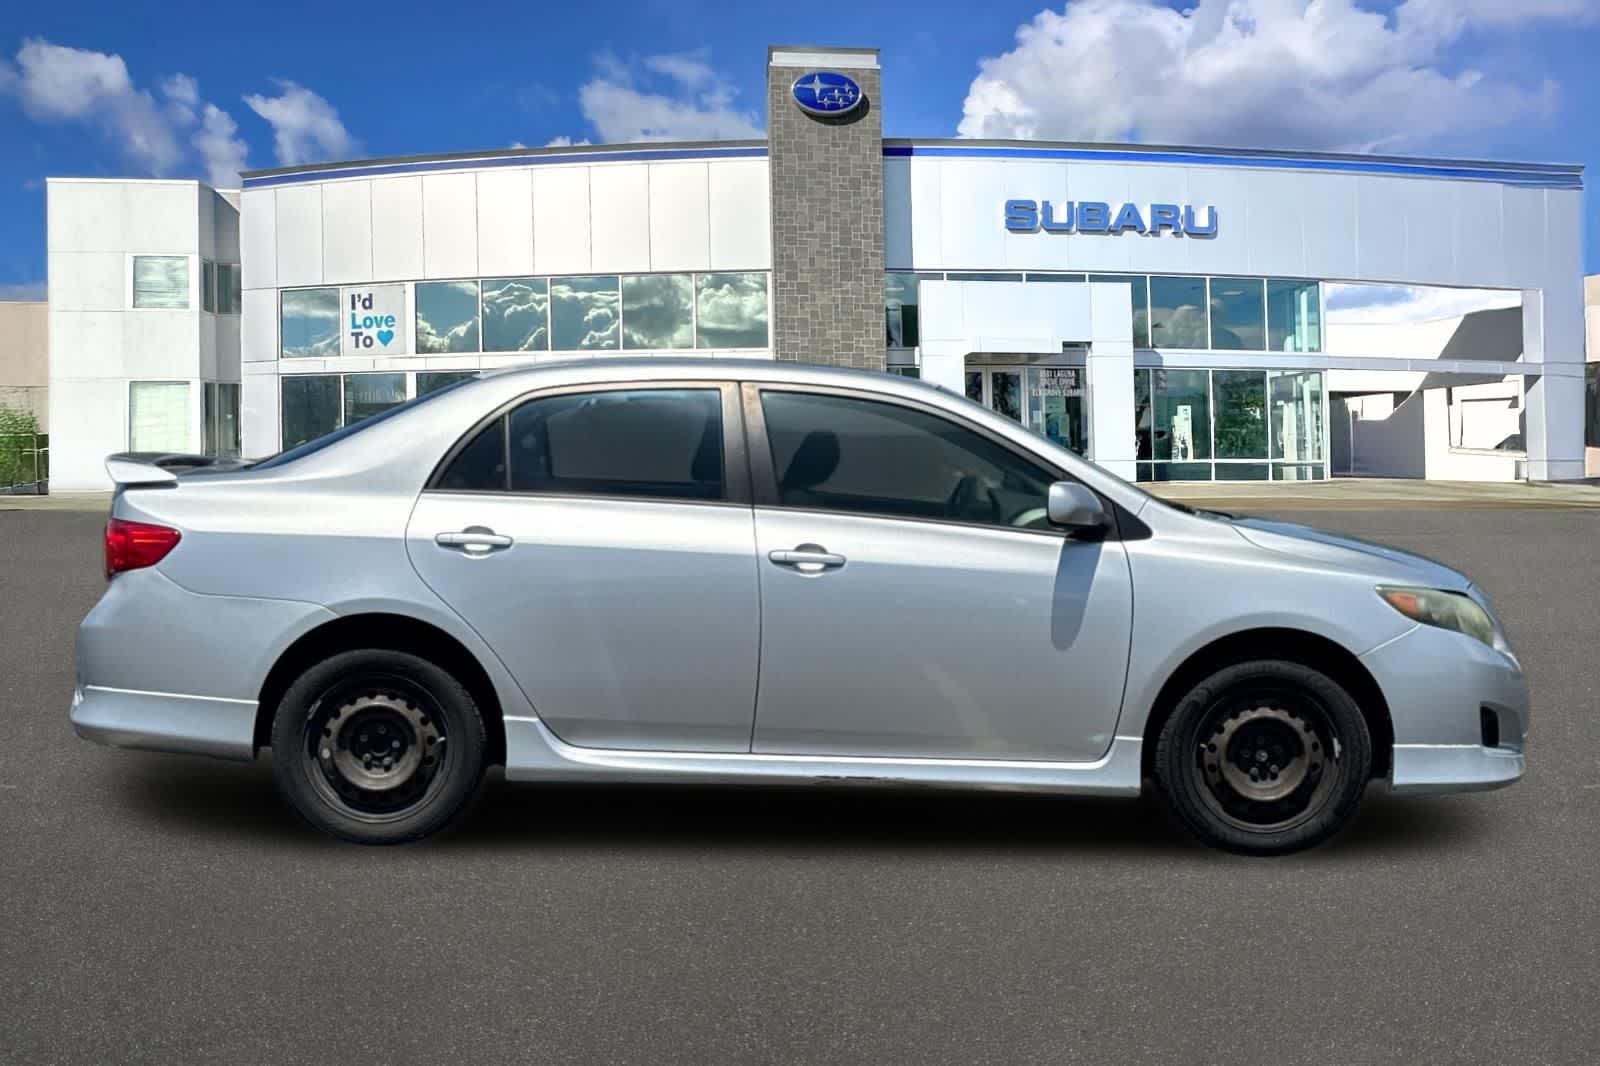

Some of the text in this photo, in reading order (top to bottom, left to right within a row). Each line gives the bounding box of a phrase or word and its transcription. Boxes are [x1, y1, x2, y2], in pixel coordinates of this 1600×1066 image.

[1004, 199, 1217, 237] SUBARU
[351, 293, 373, 310] I'd
[351, 312, 396, 329] Love
[351, 331, 374, 348] To
